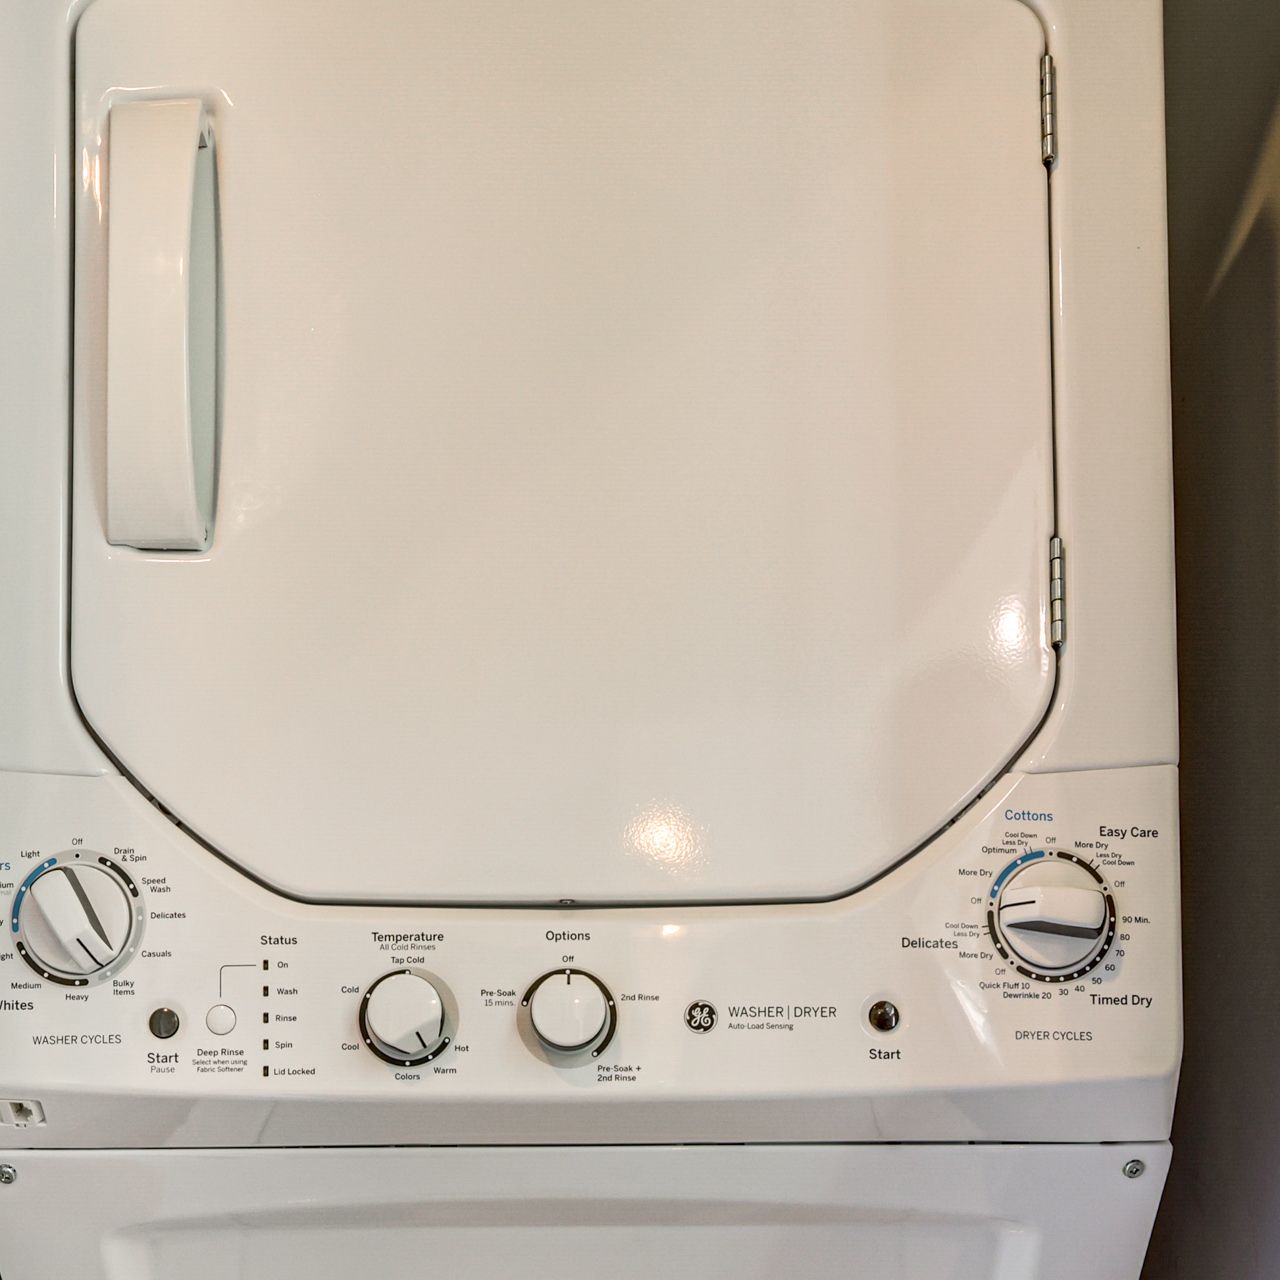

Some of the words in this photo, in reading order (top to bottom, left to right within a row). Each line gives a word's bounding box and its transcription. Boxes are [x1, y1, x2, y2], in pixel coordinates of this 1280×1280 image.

[1004, 810, 1053, 821] Cottons
[1099, 826, 1127, 839] Easy
[1130, 827, 1159, 838] Care
[71, 838, 83, 846] Off
[1095, 842, 1109, 850] Dry
[20, 850, 40, 858] Light
[981, 846, 1017, 855] Optimum
[129, 854, 147, 863] Spin
[1108, 852, 1122, 860] Dry
[979, 869, 993, 877] Dry
[141, 878, 166, 886] Speed
[1114, 880, 1125, 888] Off
[260, 935, 298, 945] Status
[371, 932, 444, 943] Temperature
[545, 931, 591, 942] Options
[901, 938, 958, 949] Delicates
[562, 955, 574, 963] Off
[980, 952, 994, 960] Dry
[391, 957, 405, 965] Tap
[113, 980, 134, 988] Bulky
[1092, 977, 1102, 985] 50
[979, 982, 1001, 990] Quick
[1021, 982, 1030, 990] 10
[480, 989, 516, 997] Pre-Soak
[1059, 988, 1069, 996] 30
[1090, 994, 1128, 1005] Timed
[1131, 995, 1152, 1008] Dry
[728, 1006, 784, 1018] WASHER
[794, 1006, 837, 1018] DRYER
[728, 1022, 764, 1030] Auto-Load
[766, 1022, 794, 1031] Sensing
[32, 1035, 78, 1045] WASHER
[80, 1035, 122, 1044] CYCLES
[1015, 1031, 1050, 1040] DRYER
[1052, 1031, 1093, 1041] CYCLES
[275, 1041, 293, 1049] Spin
[197, 1049, 219, 1057] Deep
[869, 1048, 901, 1060] Start
[147, 1053, 179, 1064] Start
[614, 1074, 637, 1082] Rinse
